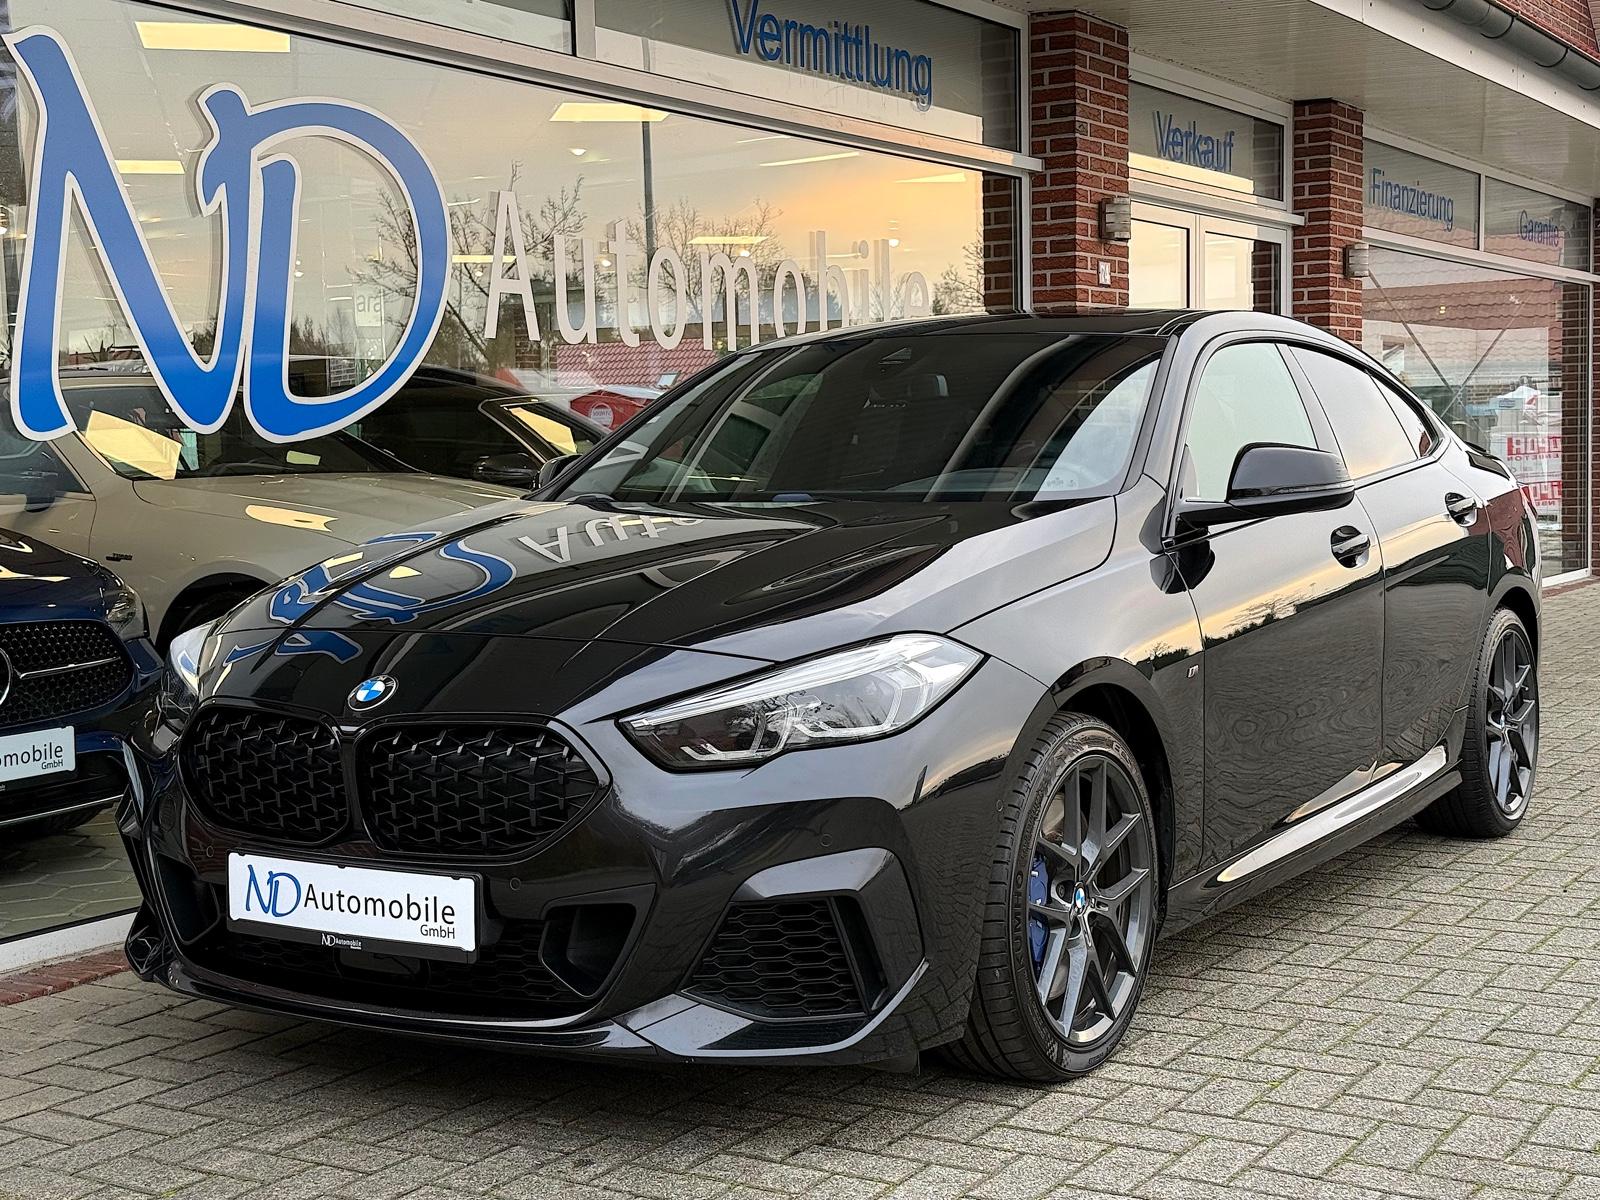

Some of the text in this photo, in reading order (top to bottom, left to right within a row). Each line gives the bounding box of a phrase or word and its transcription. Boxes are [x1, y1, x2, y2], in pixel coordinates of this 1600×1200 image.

[730, 0, 932, 112] Vermittlung
[1155, 110, 1235, 173] Verkauf
[1371, 167, 1454, 232] Finanzierung
[3, 25, 930, 443] ND Automobile
[1519, 208, 1560, 248] Garantie
[0, 741, 64, 768] mobile
[41, 759, 64, 770] GmbH
[245, 863, 456, 925] ND Automobile
[321, 932, 336, 947] ND
[419, 924, 456, 940] GmbH
